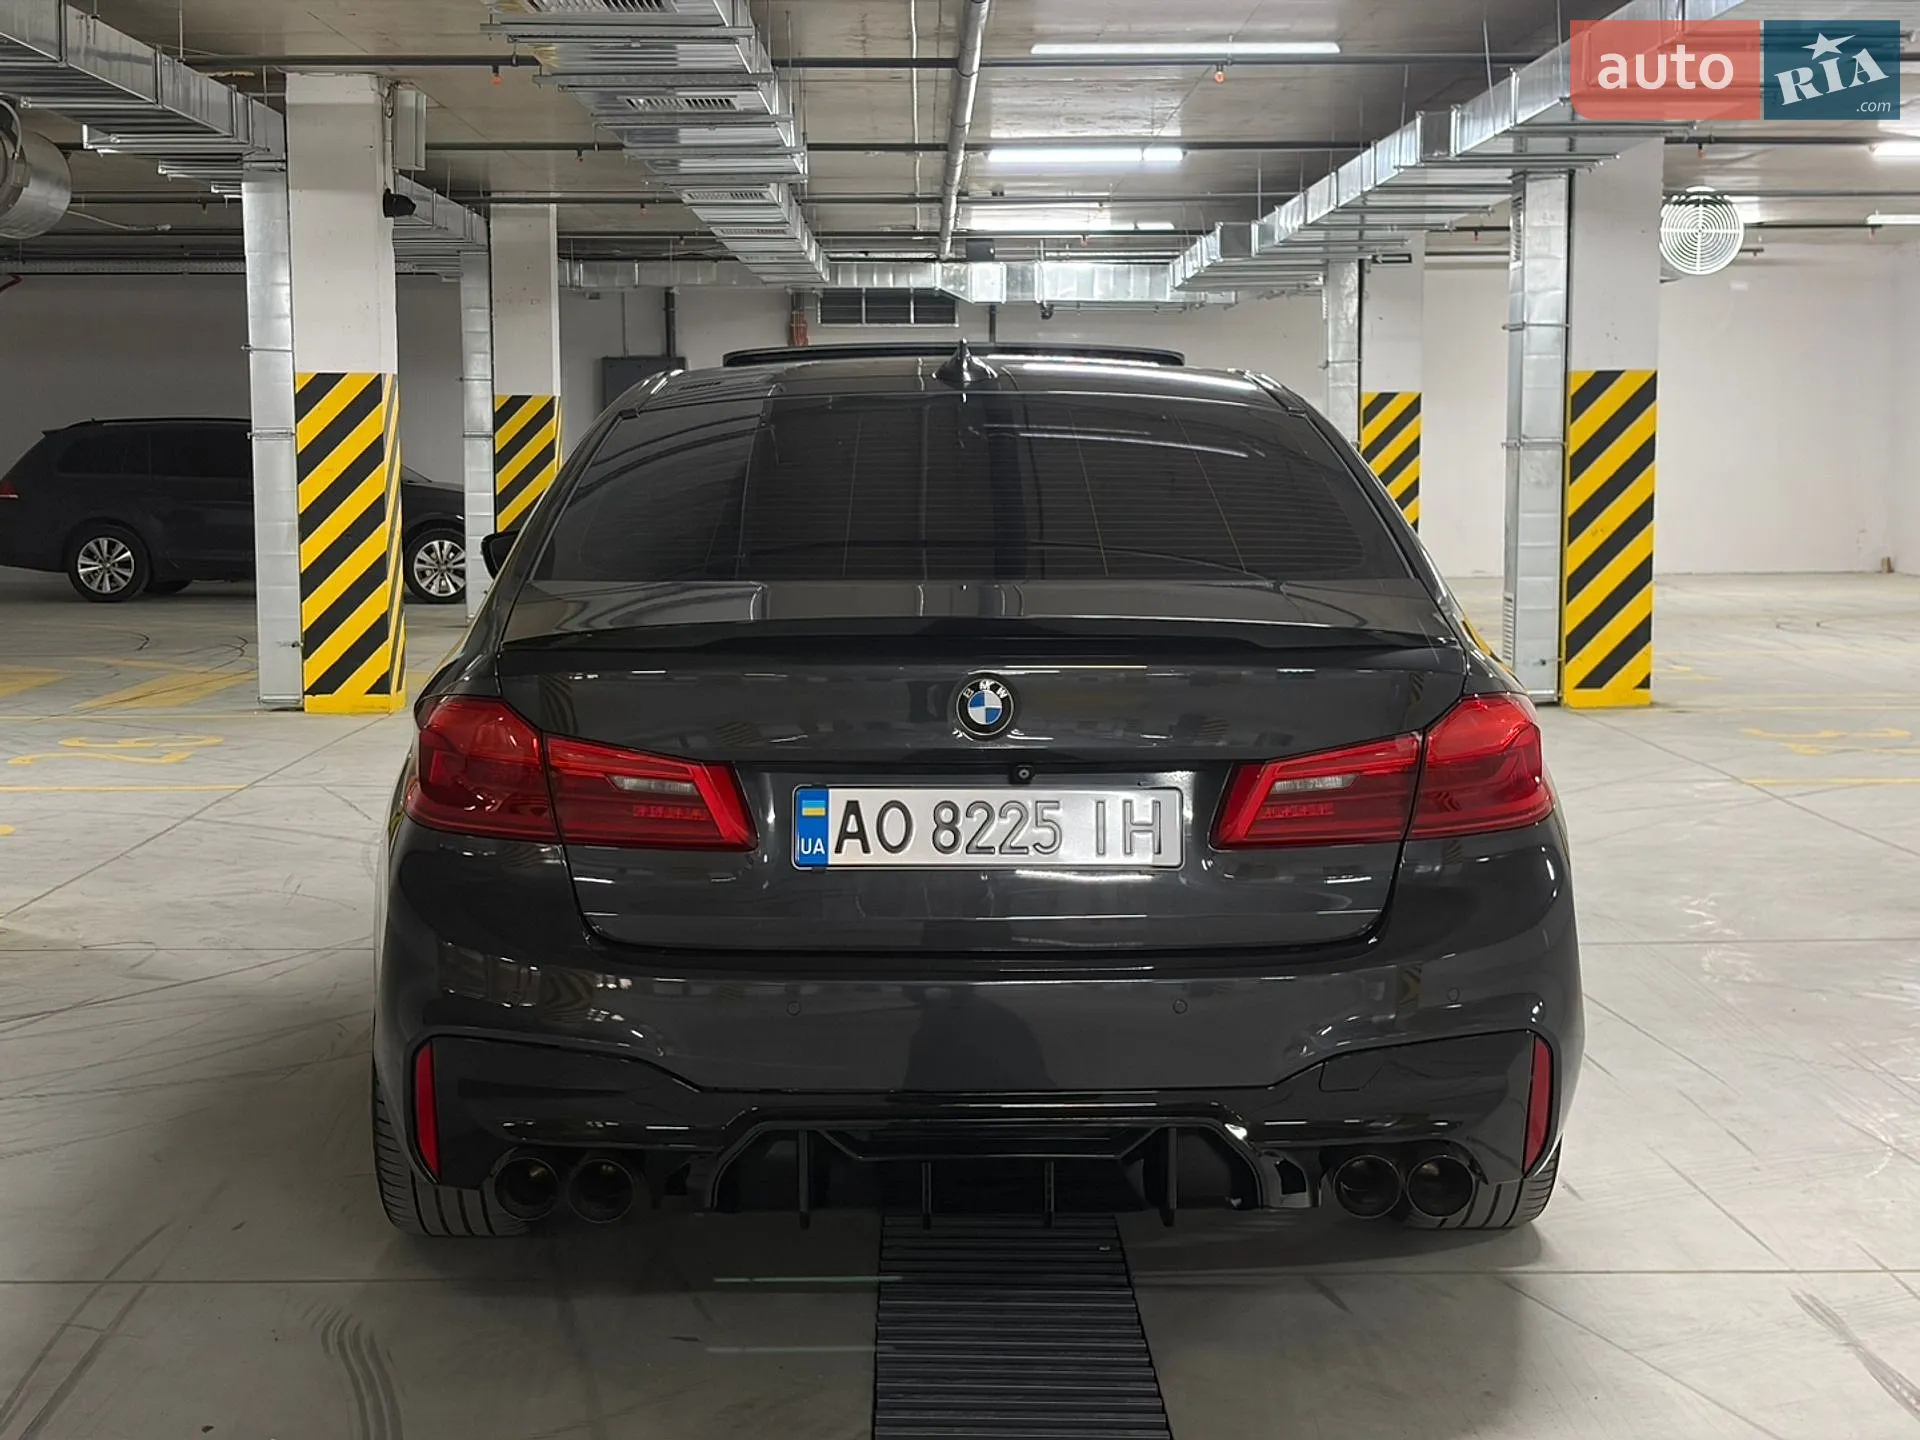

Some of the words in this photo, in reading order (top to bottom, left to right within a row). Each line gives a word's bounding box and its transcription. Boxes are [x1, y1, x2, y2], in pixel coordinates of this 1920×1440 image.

[963, 680, 1009, 699] BMW
[834, 799, 914, 855] AO
[932, 799, 1063, 855] 8225
[1095, 799, 1162, 856] IH
[800, 838, 826, 855] UA
